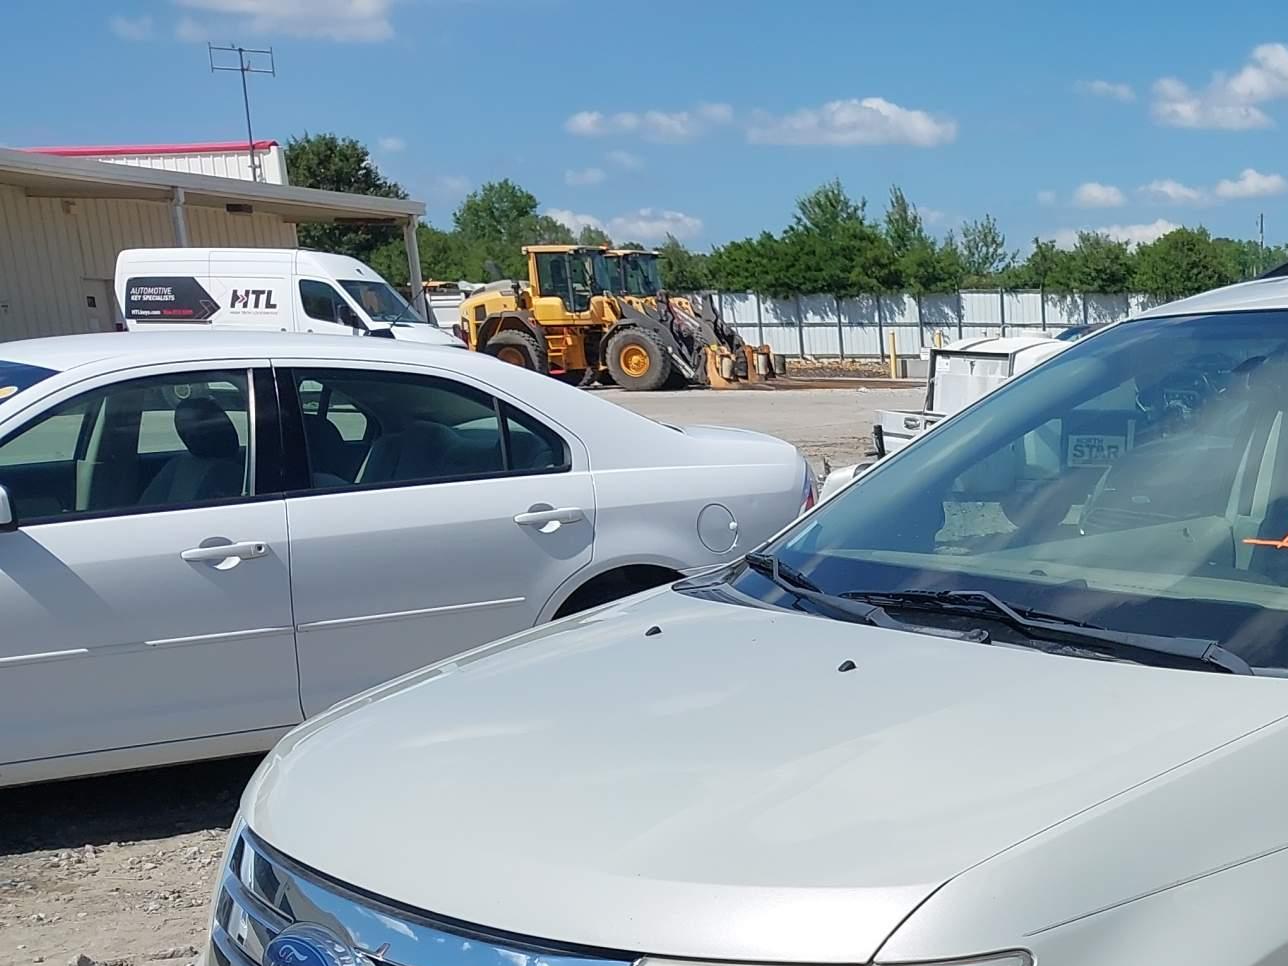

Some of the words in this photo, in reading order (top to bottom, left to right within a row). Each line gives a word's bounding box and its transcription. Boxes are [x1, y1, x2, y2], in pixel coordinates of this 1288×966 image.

[130, 287, 172, 295] AUTOMOTIVE
[230, 289, 277, 309] HTL
[1073, 444, 1120, 460] STAR
